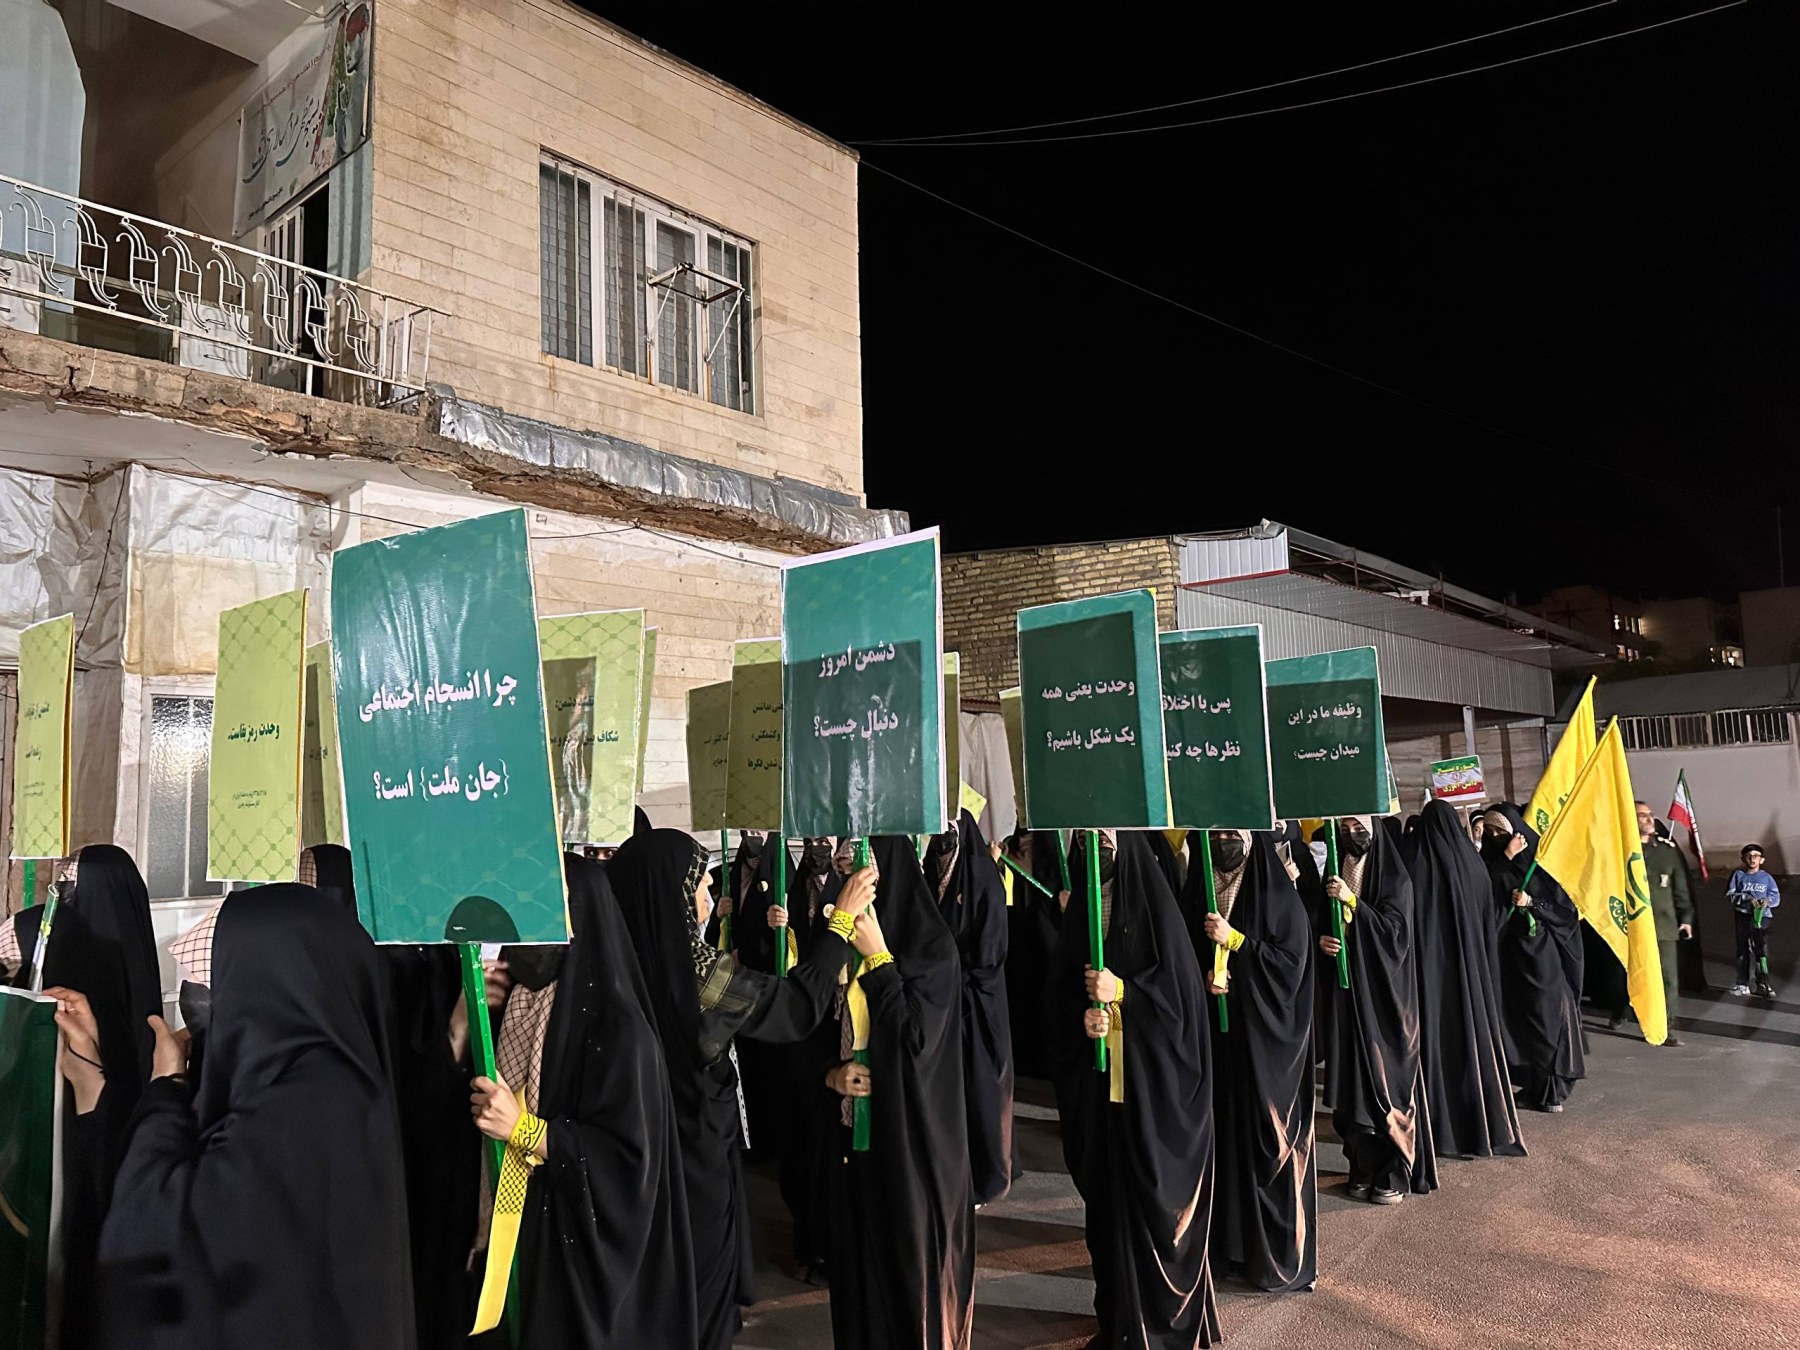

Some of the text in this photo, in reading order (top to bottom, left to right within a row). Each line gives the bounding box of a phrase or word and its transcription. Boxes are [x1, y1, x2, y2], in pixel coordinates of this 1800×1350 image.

[818, 640, 896, 678] دشمن امروز
[359, 668, 518, 723] چرا انسجام اجتماعی
[1041, 680, 1135, 701] وحدت یعنی همه
[1197, 694, 1207, 713] با
[1210, 697, 1232, 714] پس
[1287, 702, 1362, 725] وظیفه ما در این
[813, 708, 898, 741] دنبال چیست؟
[597, 730, 620, 743] شکاف
[1046, 726, 1136, 751] یک شکل باشیم؟
[1185, 745, 1203, 762] چه
[1330, 743, 1360, 760] میدان
[373, 768, 414, 800] است؟
